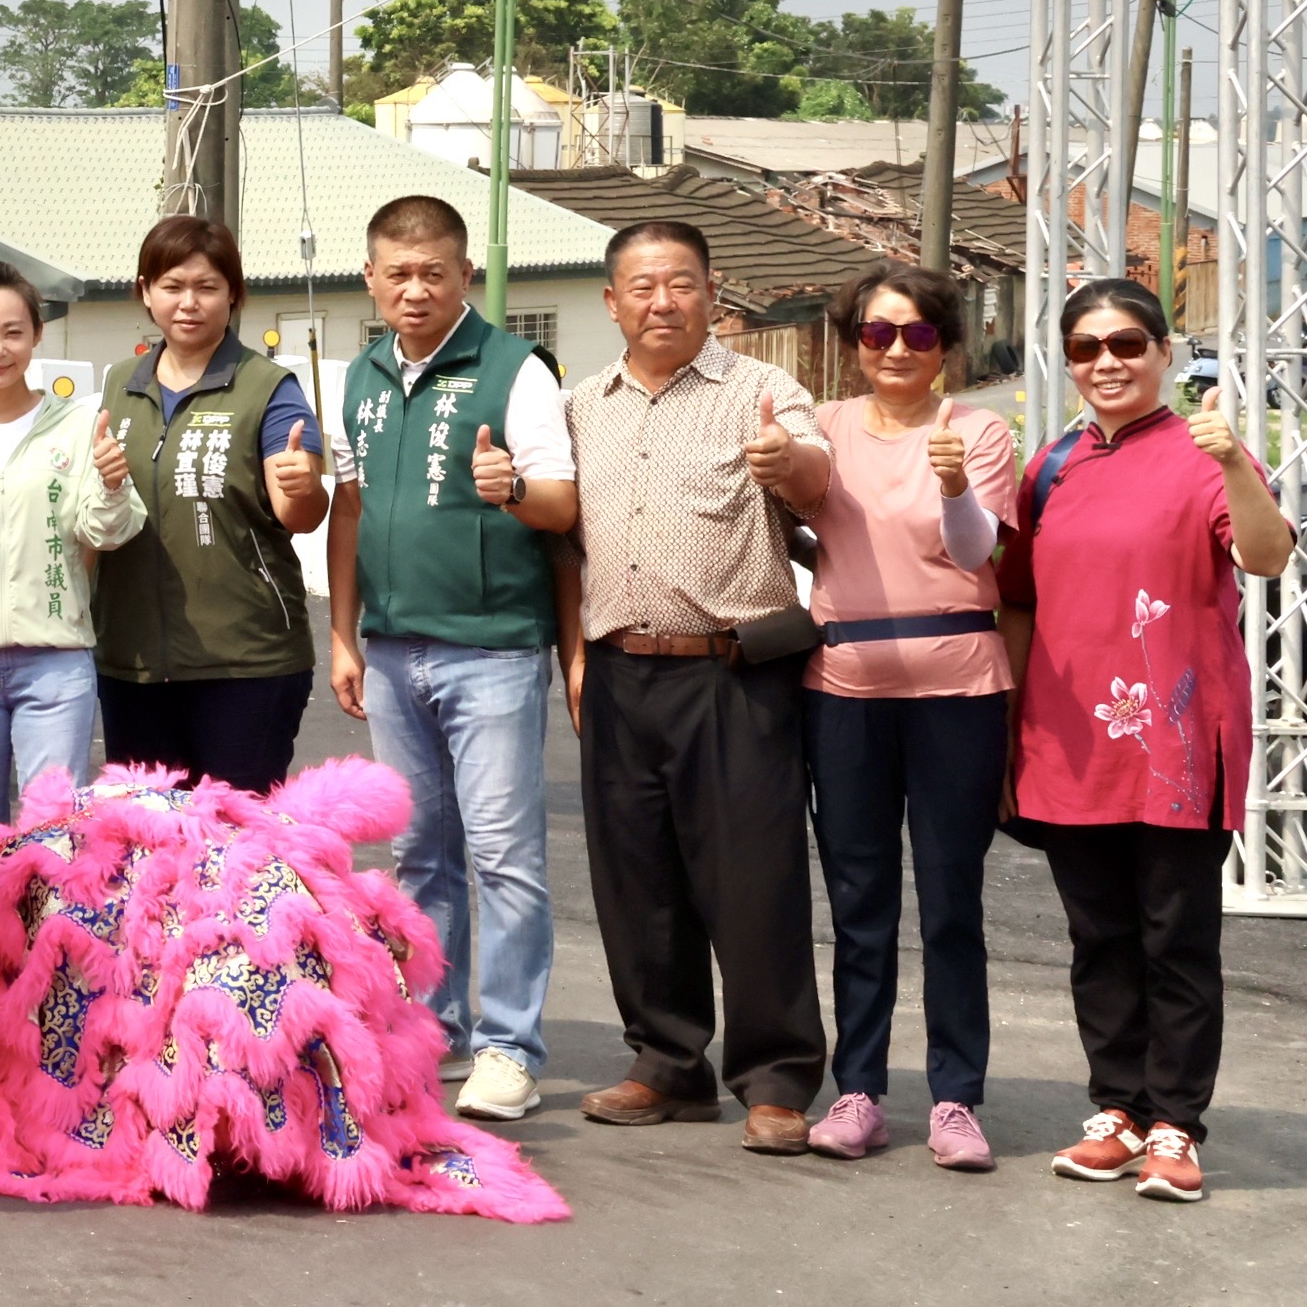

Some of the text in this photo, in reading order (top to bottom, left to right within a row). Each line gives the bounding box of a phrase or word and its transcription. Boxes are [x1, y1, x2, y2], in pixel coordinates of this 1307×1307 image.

[201, 429, 232, 499] 林俊憲
[44, 478, 67, 620] 台南市議員
